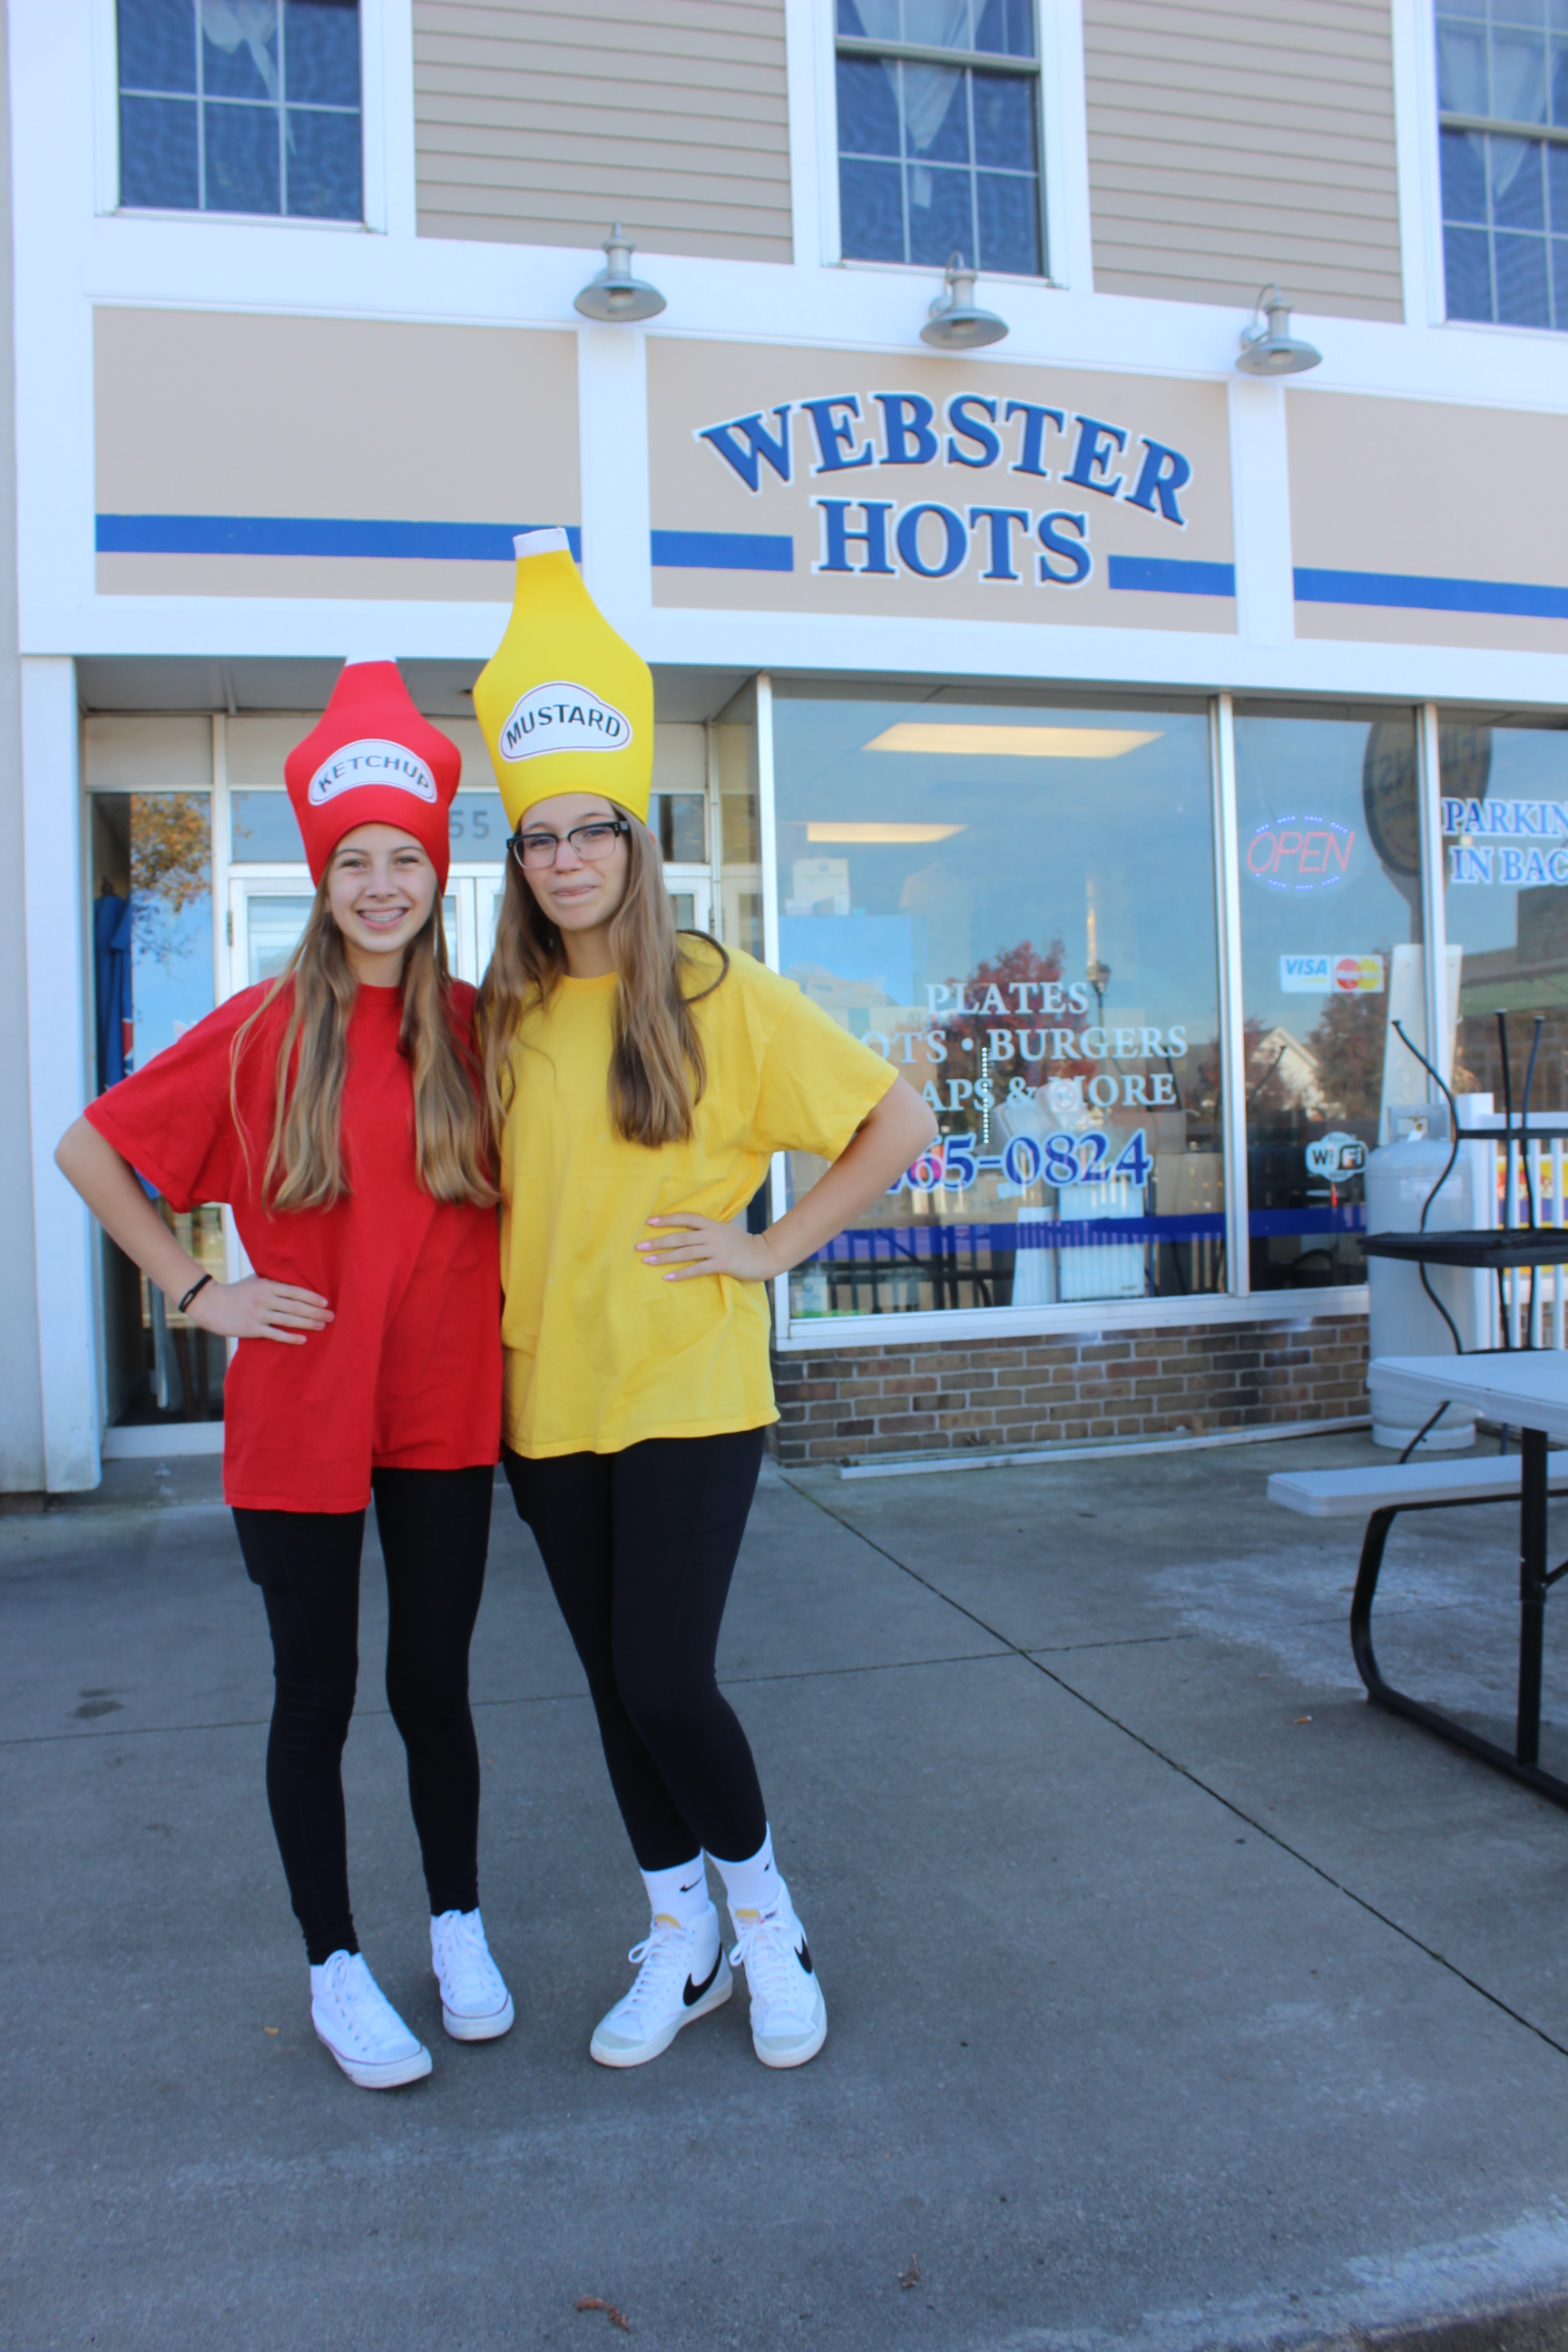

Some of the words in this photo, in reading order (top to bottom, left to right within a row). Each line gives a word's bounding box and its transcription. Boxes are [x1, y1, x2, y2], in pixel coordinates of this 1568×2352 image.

[695, 391, 1193, 528] WEBSTER
[813, 497, 1093, 588] HOTS
[506, 704, 621, 750] MUSTARD
[318, 755, 430, 793] KETCHUP
[1442, 798, 1568, 836] PARKIN
[1247, 830, 1356, 874] OPEN
[1449, 846, 1494, 883] IN
[1501, 847, 1568, 885] BAC
[1285, 958, 1328, 975] VISA
[924, 981, 1089, 1015] PLATES
[858, 1029, 948, 1064] OTS
[985, 1025, 1189, 1063] BURGERS
[922, 1076, 996, 1112] APS
[1006, 1076, 1039, 1109] &
[886, 1128, 1153, 1194] 65-0824
